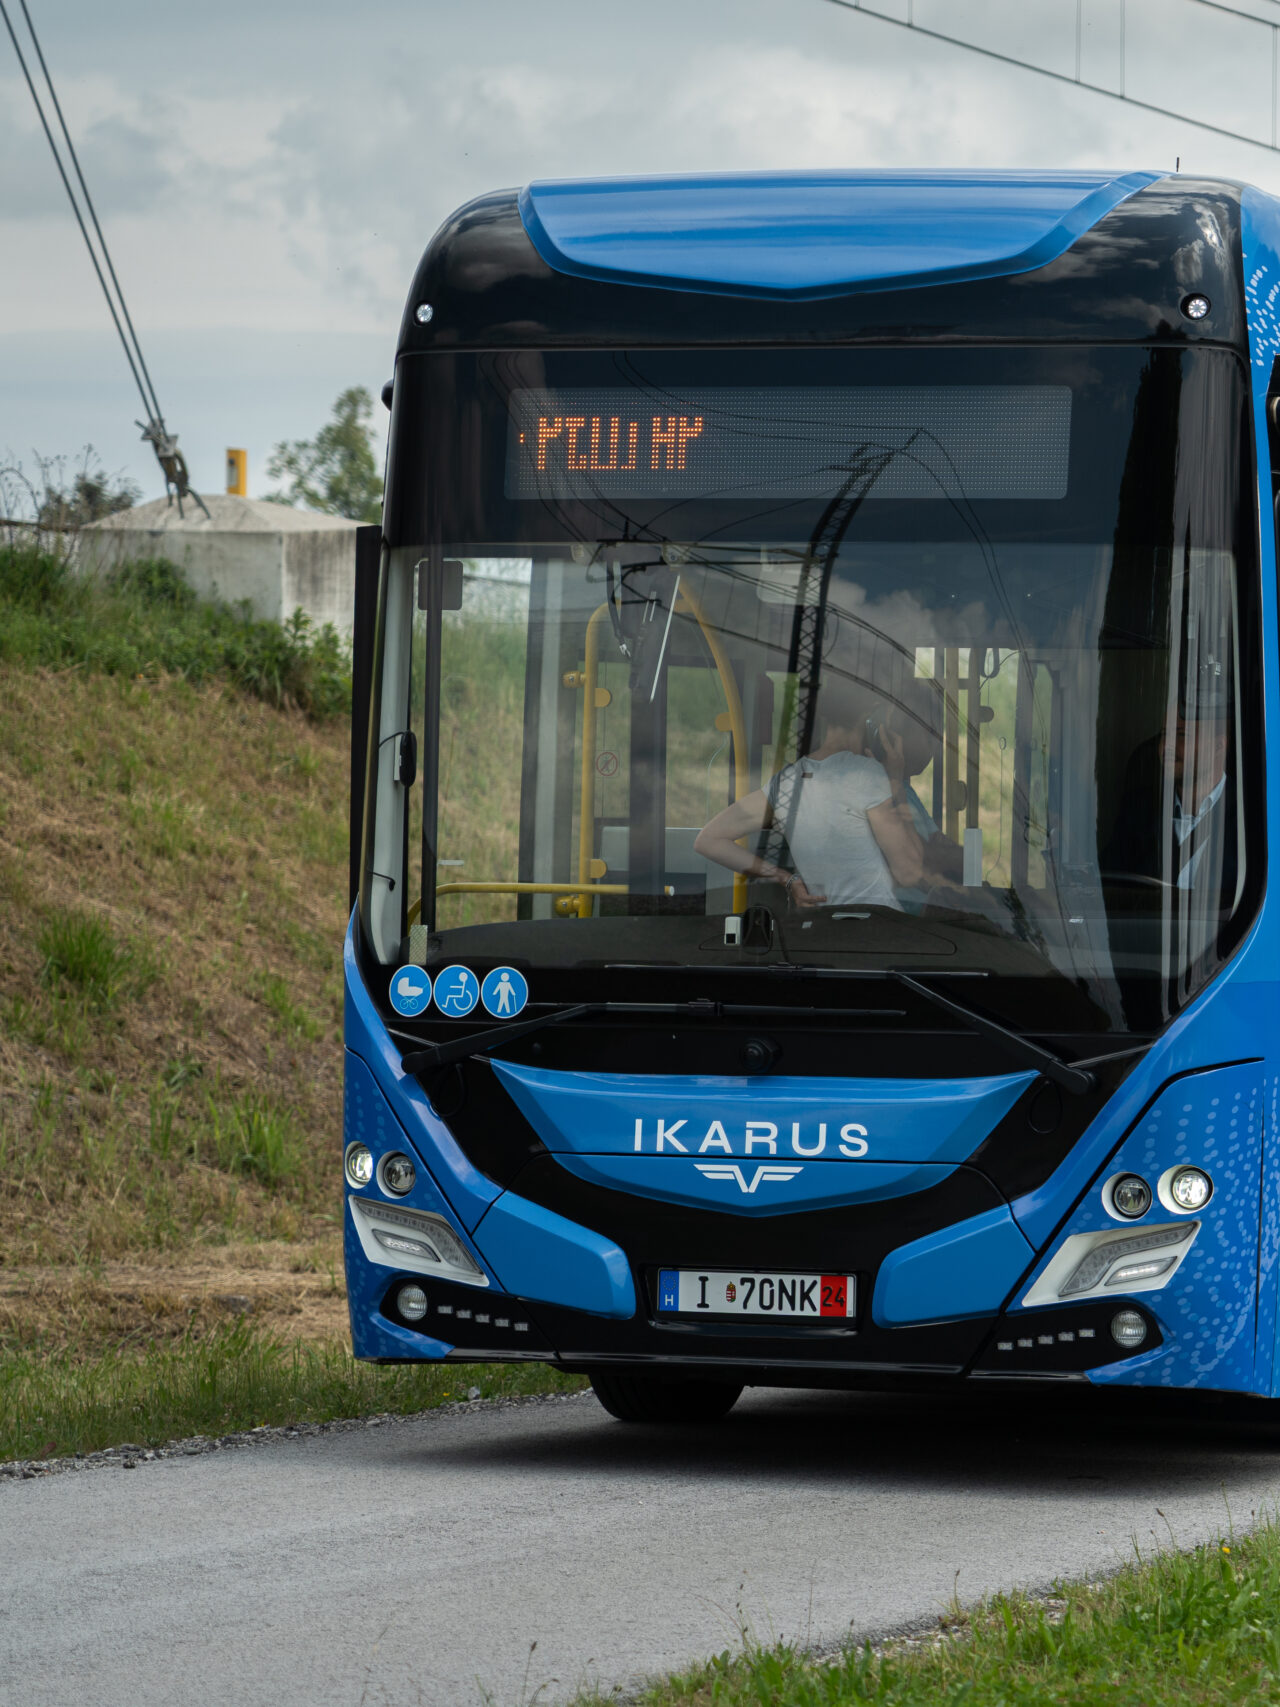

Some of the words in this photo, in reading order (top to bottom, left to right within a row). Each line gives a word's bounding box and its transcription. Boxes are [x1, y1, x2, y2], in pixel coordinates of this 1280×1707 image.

[633, 1118, 870, 1157] IKARUS
[664, 1294, 674, 1306] H
[696, 1275, 710, 1308] I
[822, 1286, 845, 1307] 24
